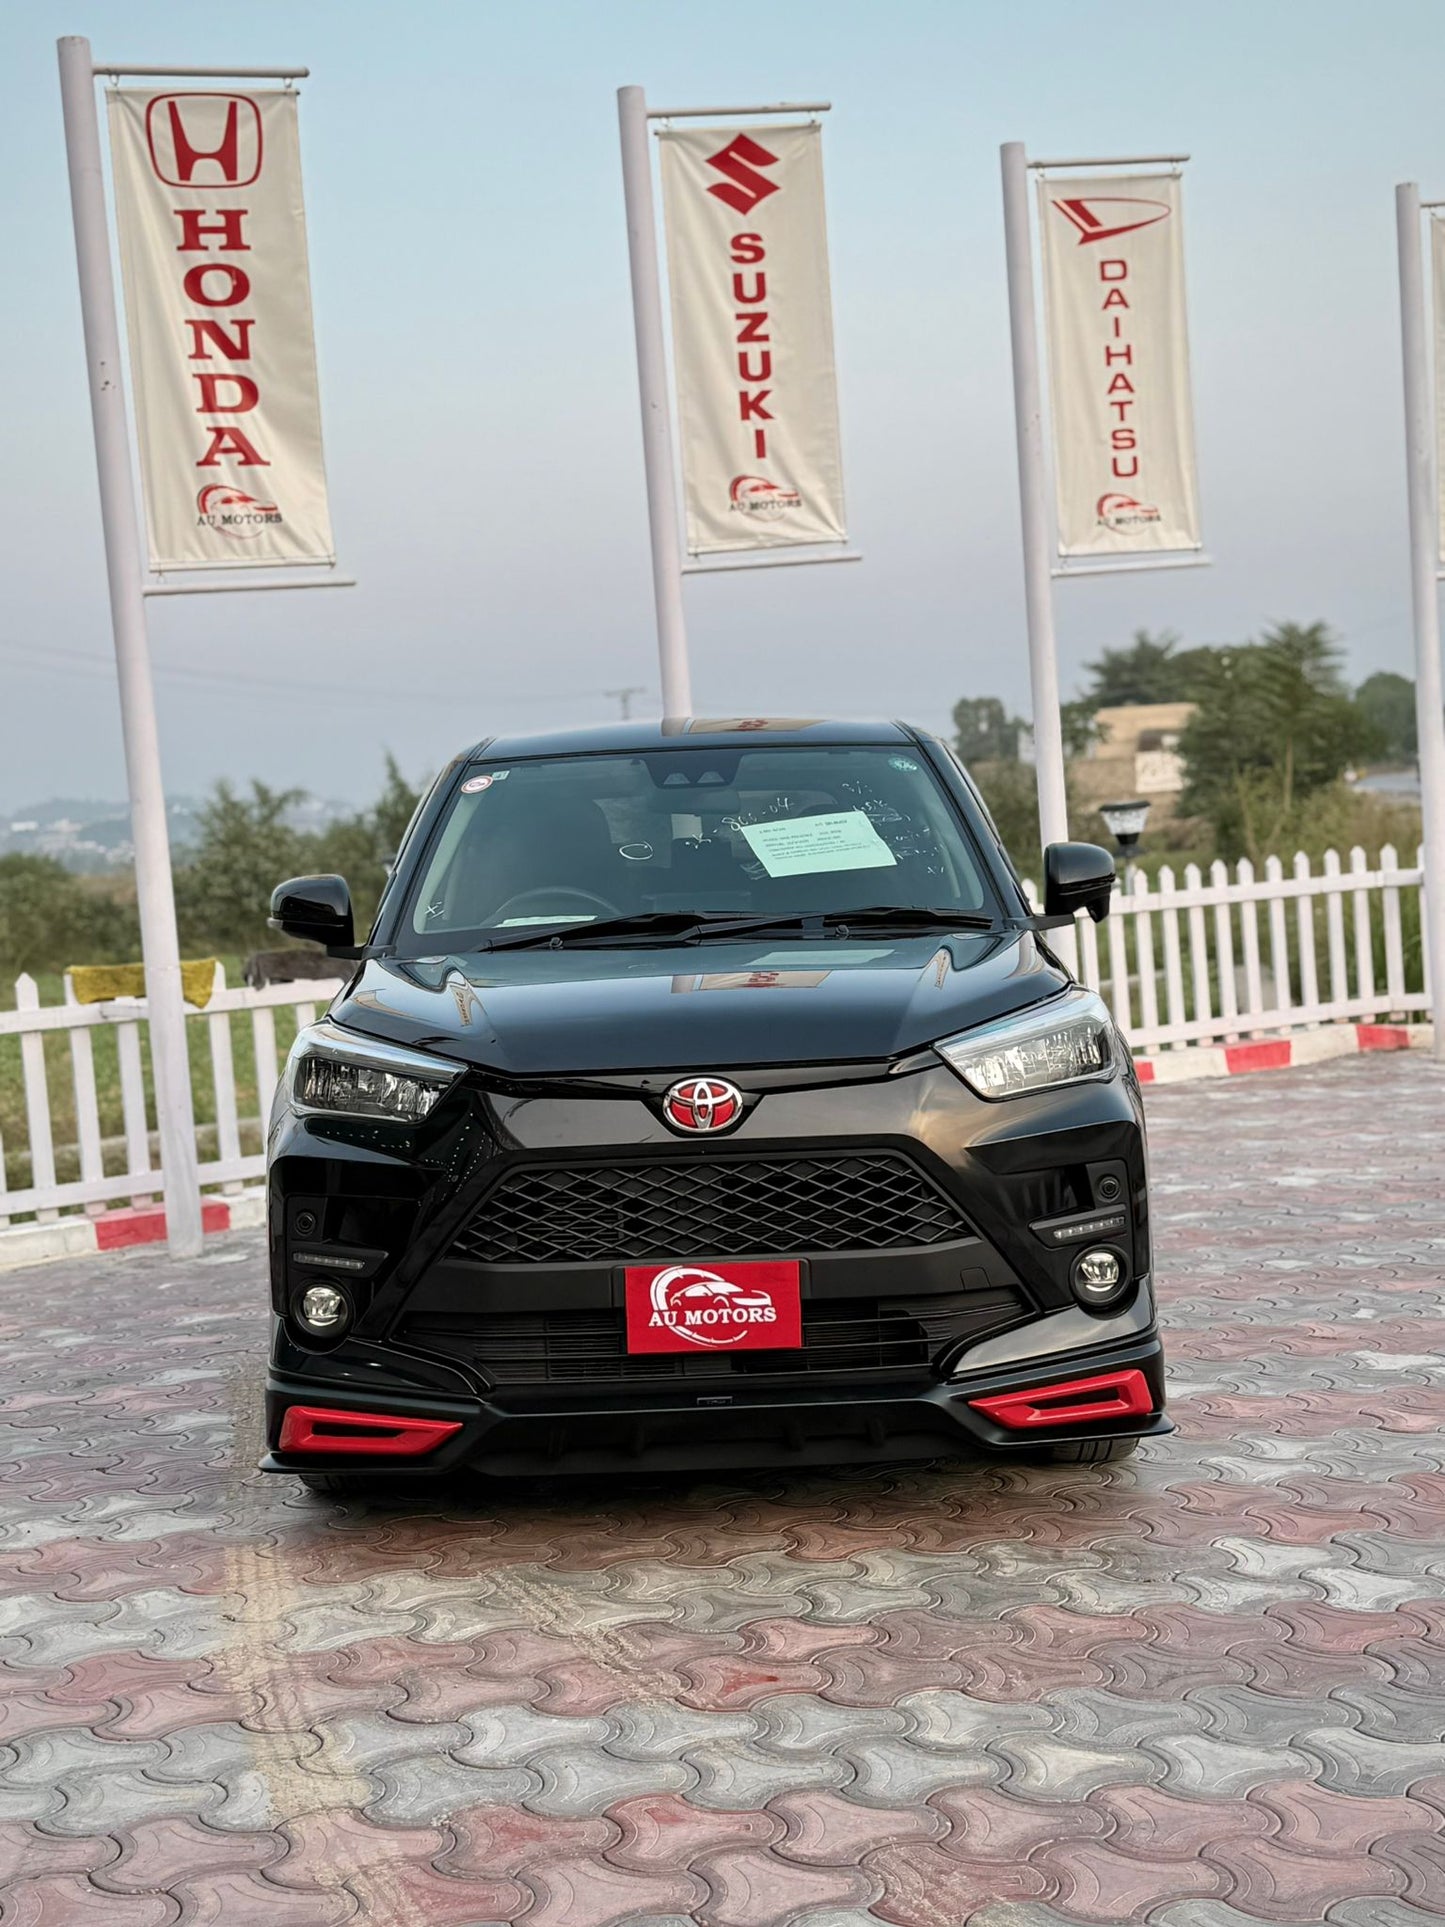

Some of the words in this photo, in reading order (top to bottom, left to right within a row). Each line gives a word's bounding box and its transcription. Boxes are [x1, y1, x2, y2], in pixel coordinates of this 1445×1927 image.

[173, 209, 271, 467] HONDA
[729, 232, 775, 460] SUZUKI
[1099, 259, 1139, 478] DAIHATSU
[196, 514, 217, 526] AU
[221, 512, 283, 525] MOTORS
[649, 1311, 678, 1327] AU
[684, 1307, 777, 1326] MOTORS
